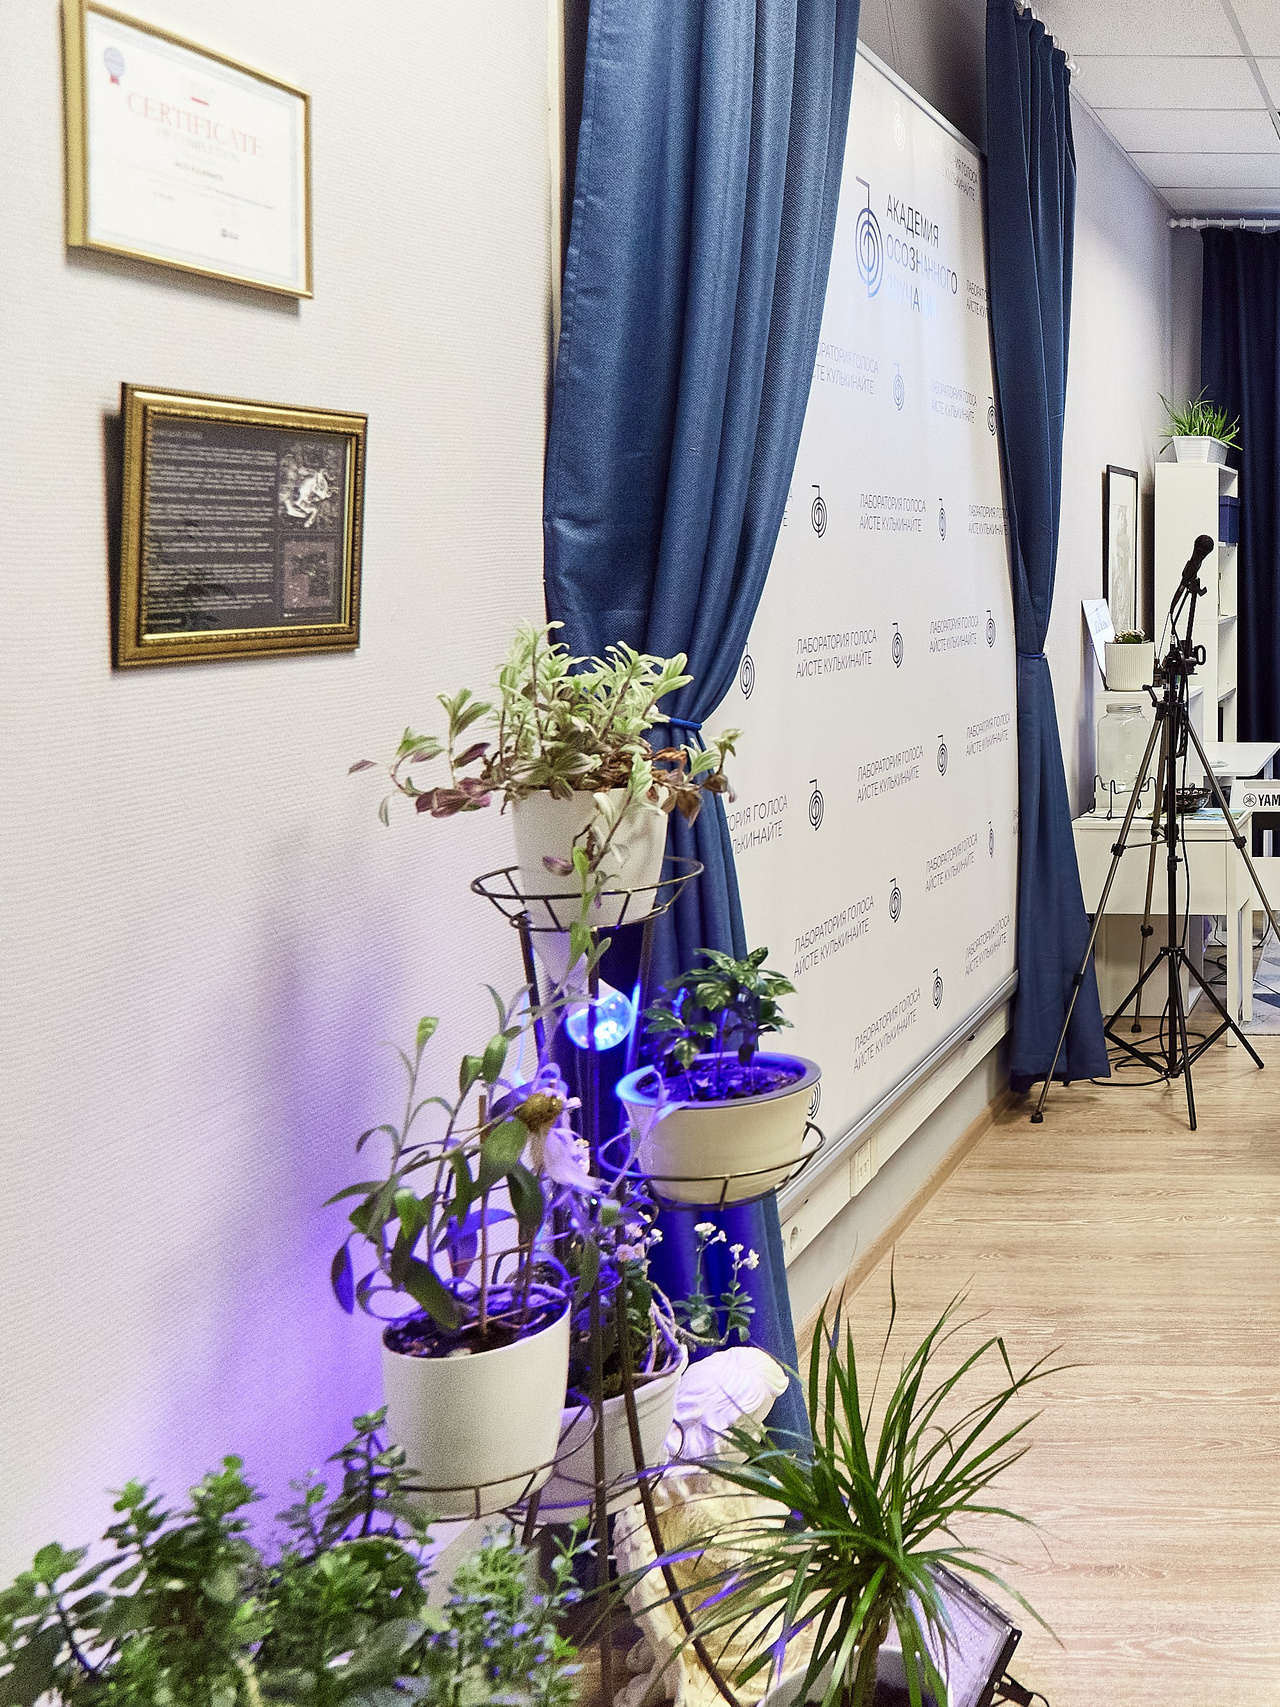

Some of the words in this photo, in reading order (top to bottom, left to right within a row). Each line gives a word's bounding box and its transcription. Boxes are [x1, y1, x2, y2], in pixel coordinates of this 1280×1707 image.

[127, 92, 266, 158] CERTIFICATE
[886, 193, 939, 249] АКАДЕМИЯ
[886, 233, 958, 295] ОСОЗНАННОГО
[827, 366, 874, 395] КУЛЬКИНАЙТЕ
[853, 352, 879, 374] ГОЛОСА
[860, 493, 902, 511] ЛАБОРАТОРИЯ
[903, 497, 926, 513] ГОЛОСА
[860, 513, 881, 531] АЙСТЕ
[882, 516, 922, 533] КУЛЬКИНАЙТЕ
[796, 632, 849, 655] ЛАБОРАТОРИЯ
[851, 629, 877, 646] ГОЛОСА
[796, 658, 822, 679] АЙСТЕ
[824, 649, 872, 673] КУЛЬКИНАЙТЕ
[857, 752, 901, 781] ЛАБОРАТОРИЯ
[902, 745, 923, 766] ГОЛОСА
[857, 781, 878, 803] АЙСТЕ
[879, 764, 919, 793] КУЛЬКИНАЙТЕ
[753, 794, 788, 822] ГОЛОСА
[794, 910, 847, 955] ЛАБОРАТОРИЯ
[848, 895, 875, 922] ГОЛОСА
[794, 948, 819, 979] АЙСТЕ
[820, 917, 869, 961] КУЛЬКИНАЙТЕ
[854, 1005, 898, 1052] ЛАБОРАТОРИЯ
[899, 987, 921, 1015] ГОЛОСА
[854, 1043, 875, 1074] АЙСТЕ
[875, 1008, 917, 1054] КУЛЬКИНАЙТЕ
